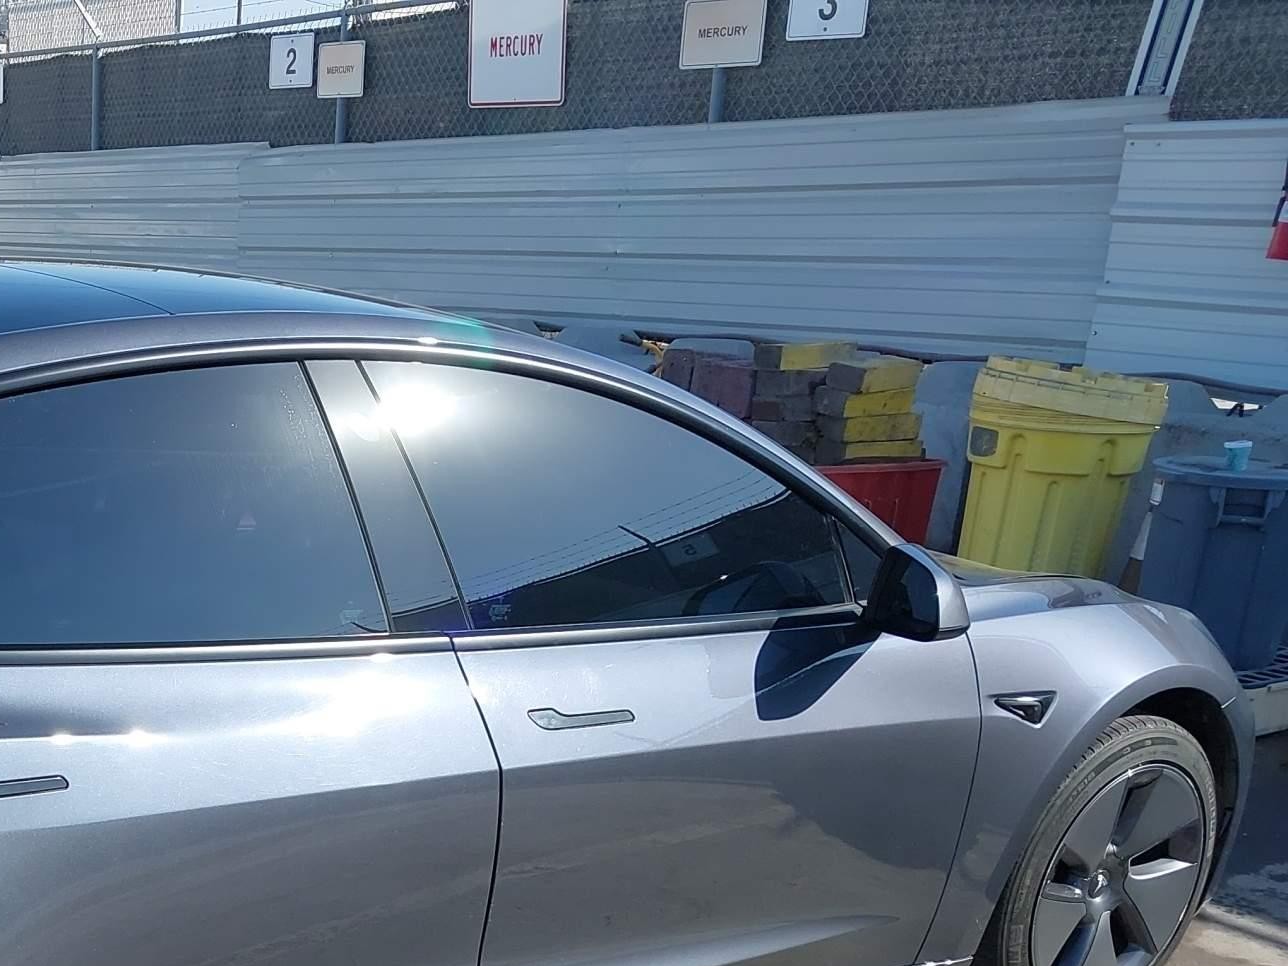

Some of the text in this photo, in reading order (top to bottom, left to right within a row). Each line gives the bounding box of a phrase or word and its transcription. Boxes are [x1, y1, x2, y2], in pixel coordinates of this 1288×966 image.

[697, 25, 748, 39] MERCURY
[489, 33, 544, 58] MERCURY
[285, 46, 297, 75] 2
[326, 65, 355, 75] MERCURY
